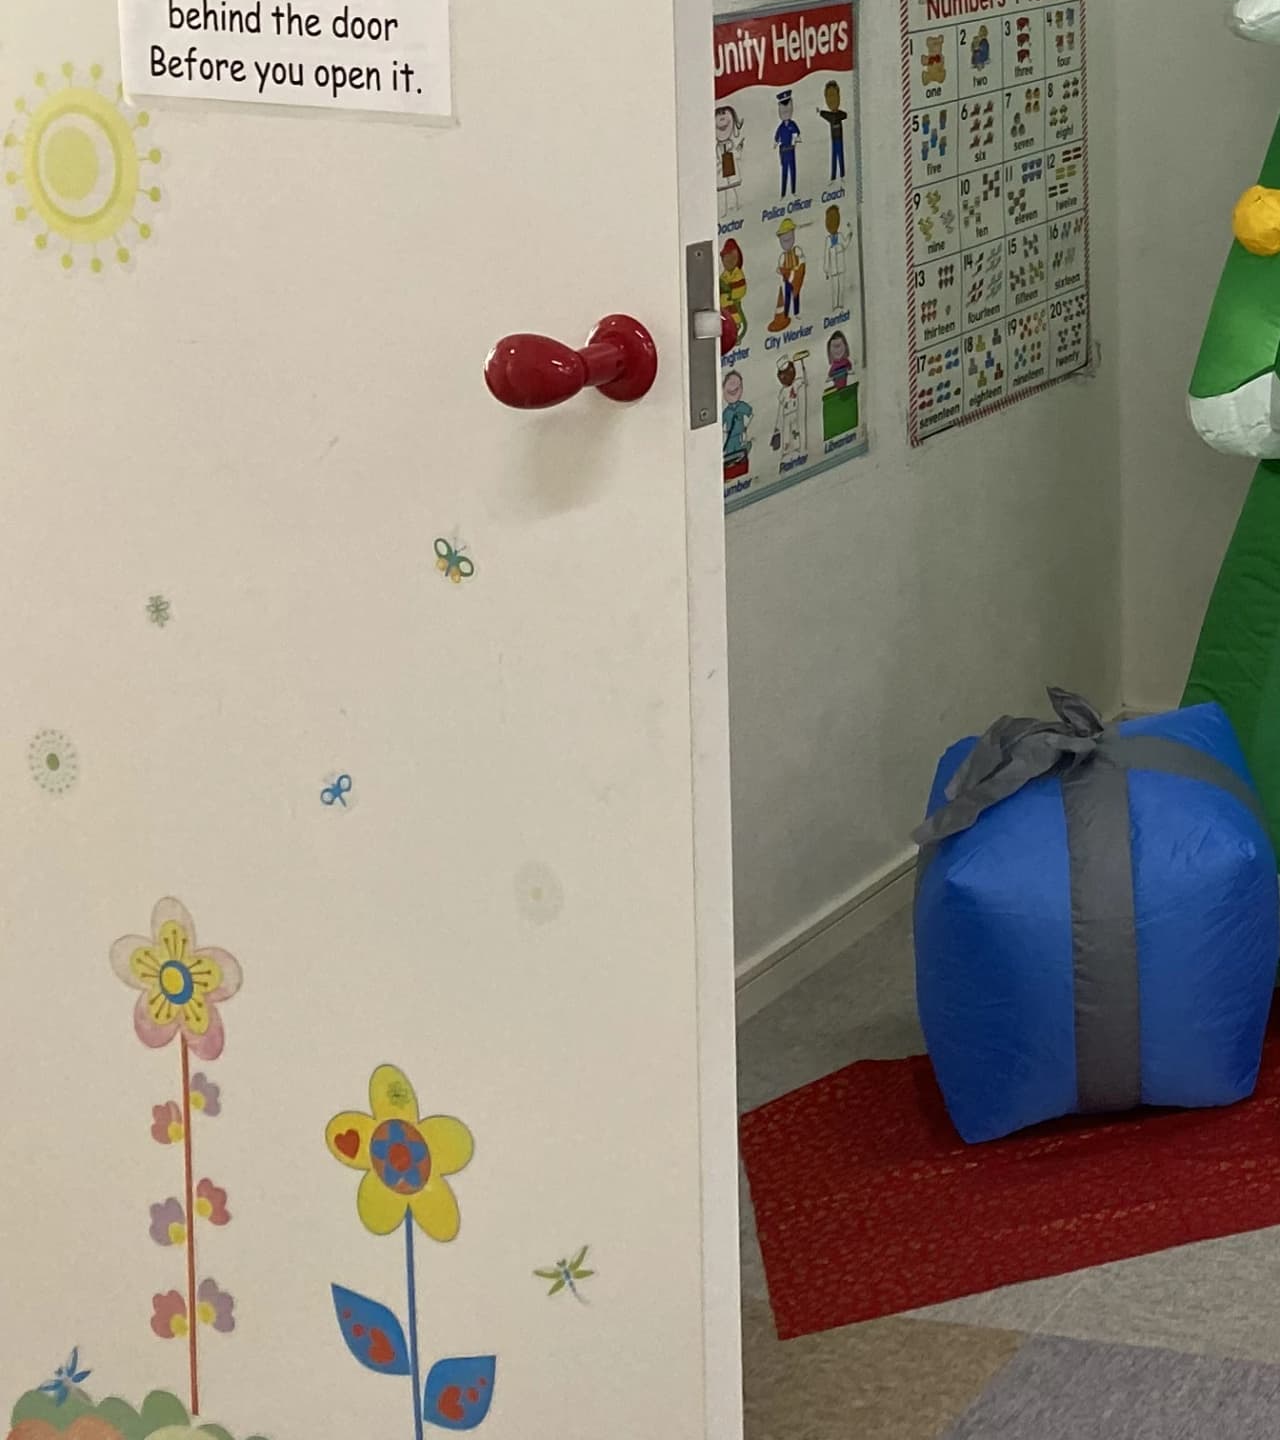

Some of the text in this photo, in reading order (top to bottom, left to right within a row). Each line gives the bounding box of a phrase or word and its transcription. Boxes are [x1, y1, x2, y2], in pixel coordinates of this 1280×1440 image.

[271, 2, 322, 37] the
[332, 5, 398, 41] door
[771, 16, 848, 69] Helpers
[150, 44, 423, 98] Before you open it.
[1014, 65, 1034, 77] three
[973, 75, 988, 88] two
[926, 87, 942, 98] one
[1013, 138, 1035, 151] seven
[974, 151, 986, 162] six
[926, 163, 942, 175] five
[821, 188, 845, 204] Coach
[761, 197, 812, 222] Police Officer
[976, 225, 988, 238] ten
[927, 241, 945, 254] nine
[823, 310, 851, 329] Dentist
[764, 324, 813, 350] City Worker
